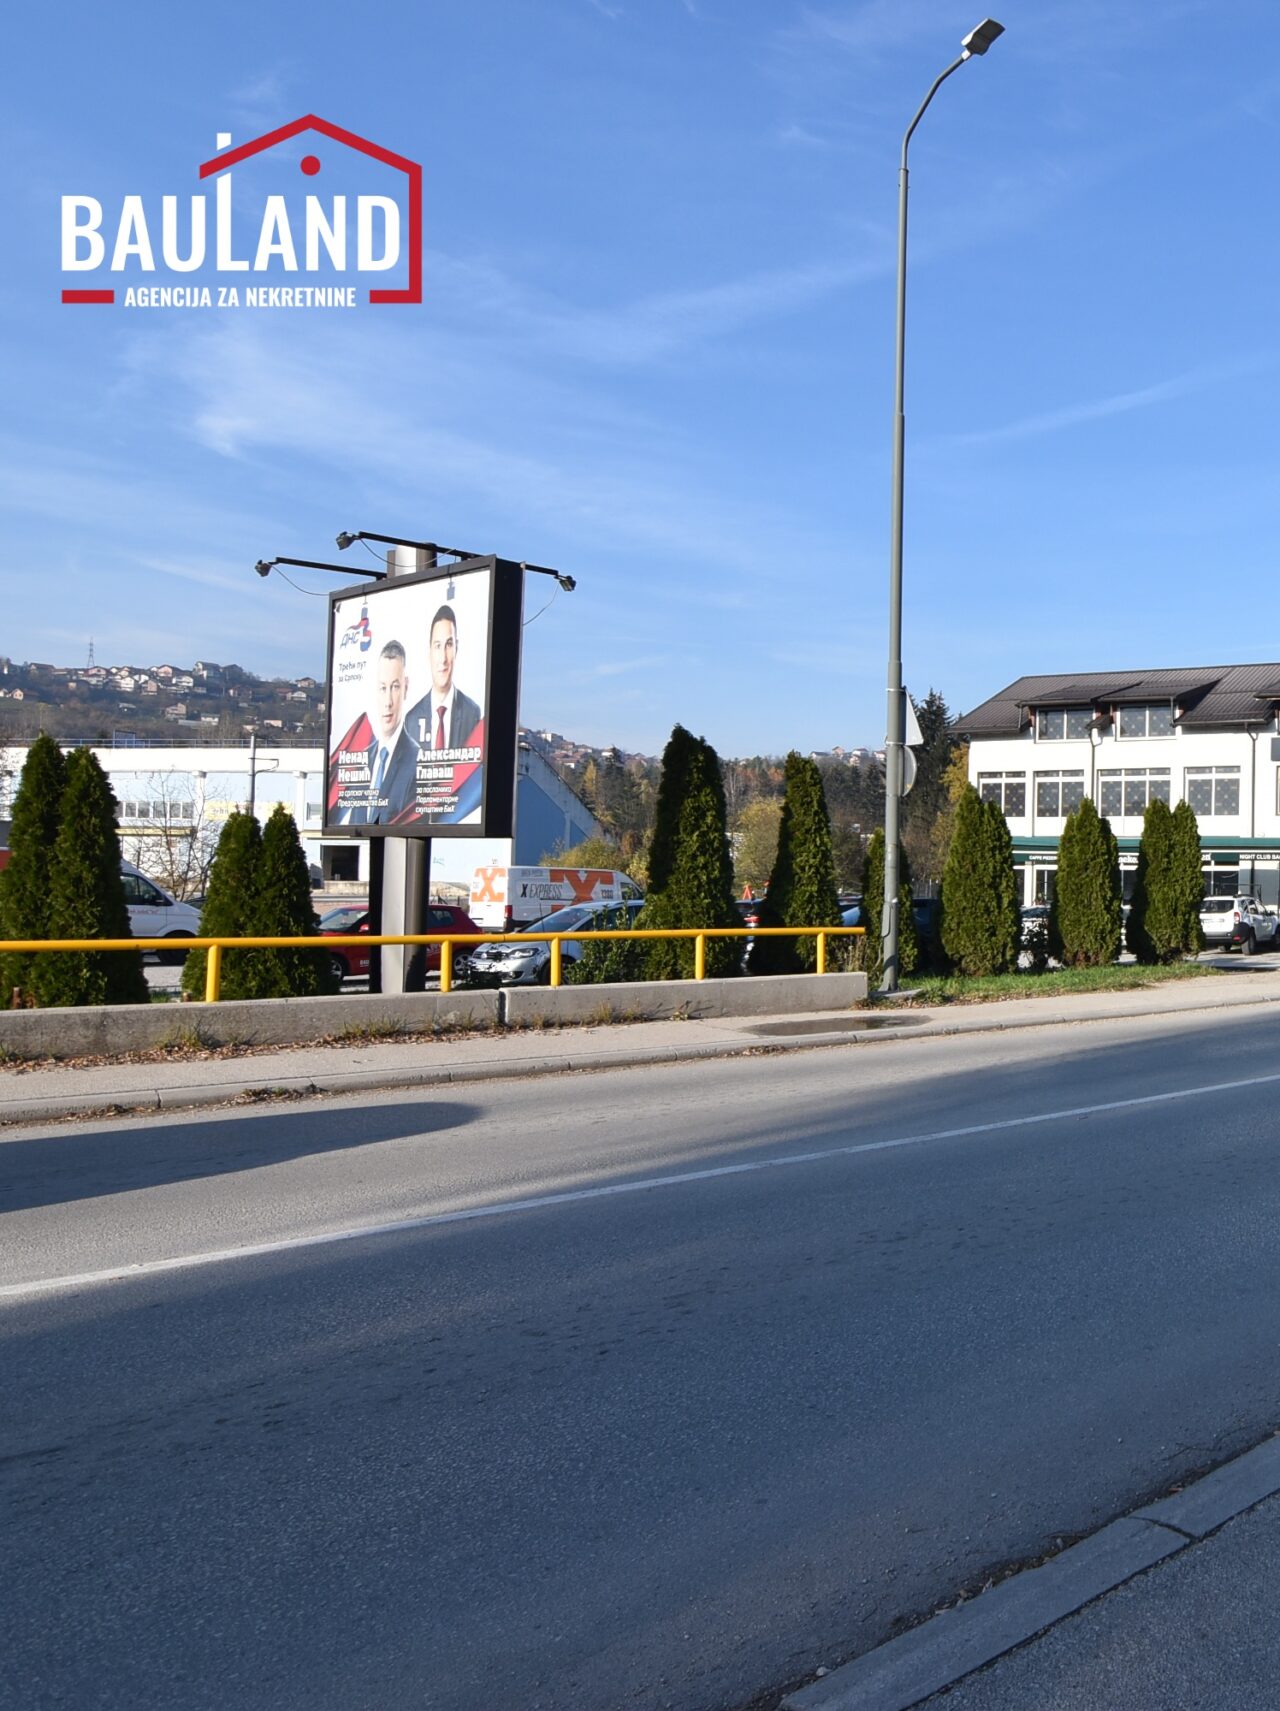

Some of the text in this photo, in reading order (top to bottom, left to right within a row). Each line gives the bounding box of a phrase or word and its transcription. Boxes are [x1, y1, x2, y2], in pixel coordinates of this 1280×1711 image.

[418, 718, 431, 742] 1.
[338, 750, 369, 765] Ненад
[416, 747, 482, 762] Александар
[338, 767, 370, 782] Нешић
[416, 766, 454, 780] Главаш
[520, 883, 563, 899] X EXPRESS
